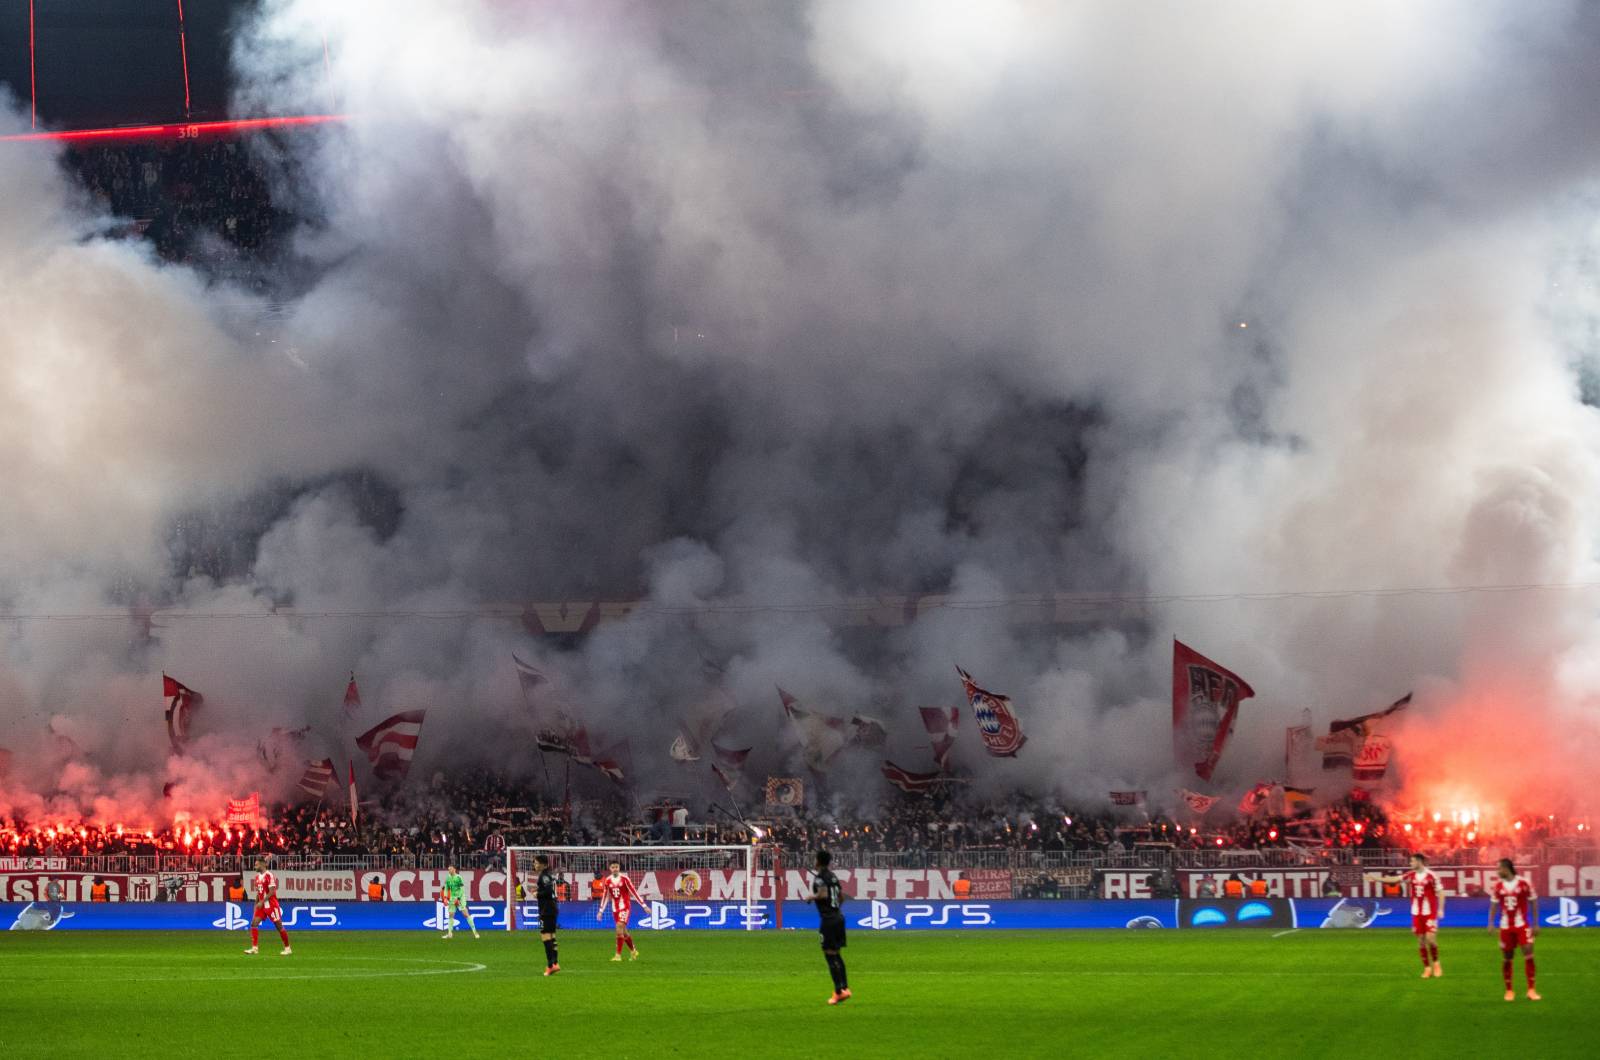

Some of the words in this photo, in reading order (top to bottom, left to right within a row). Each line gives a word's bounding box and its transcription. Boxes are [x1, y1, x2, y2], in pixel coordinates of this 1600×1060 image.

[178, 126, 199, 139] 318
[969, 869, 1010, 880] ULTRAS
[684, 905, 768, 925] PS5
[904, 904, 992, 925] PS5
